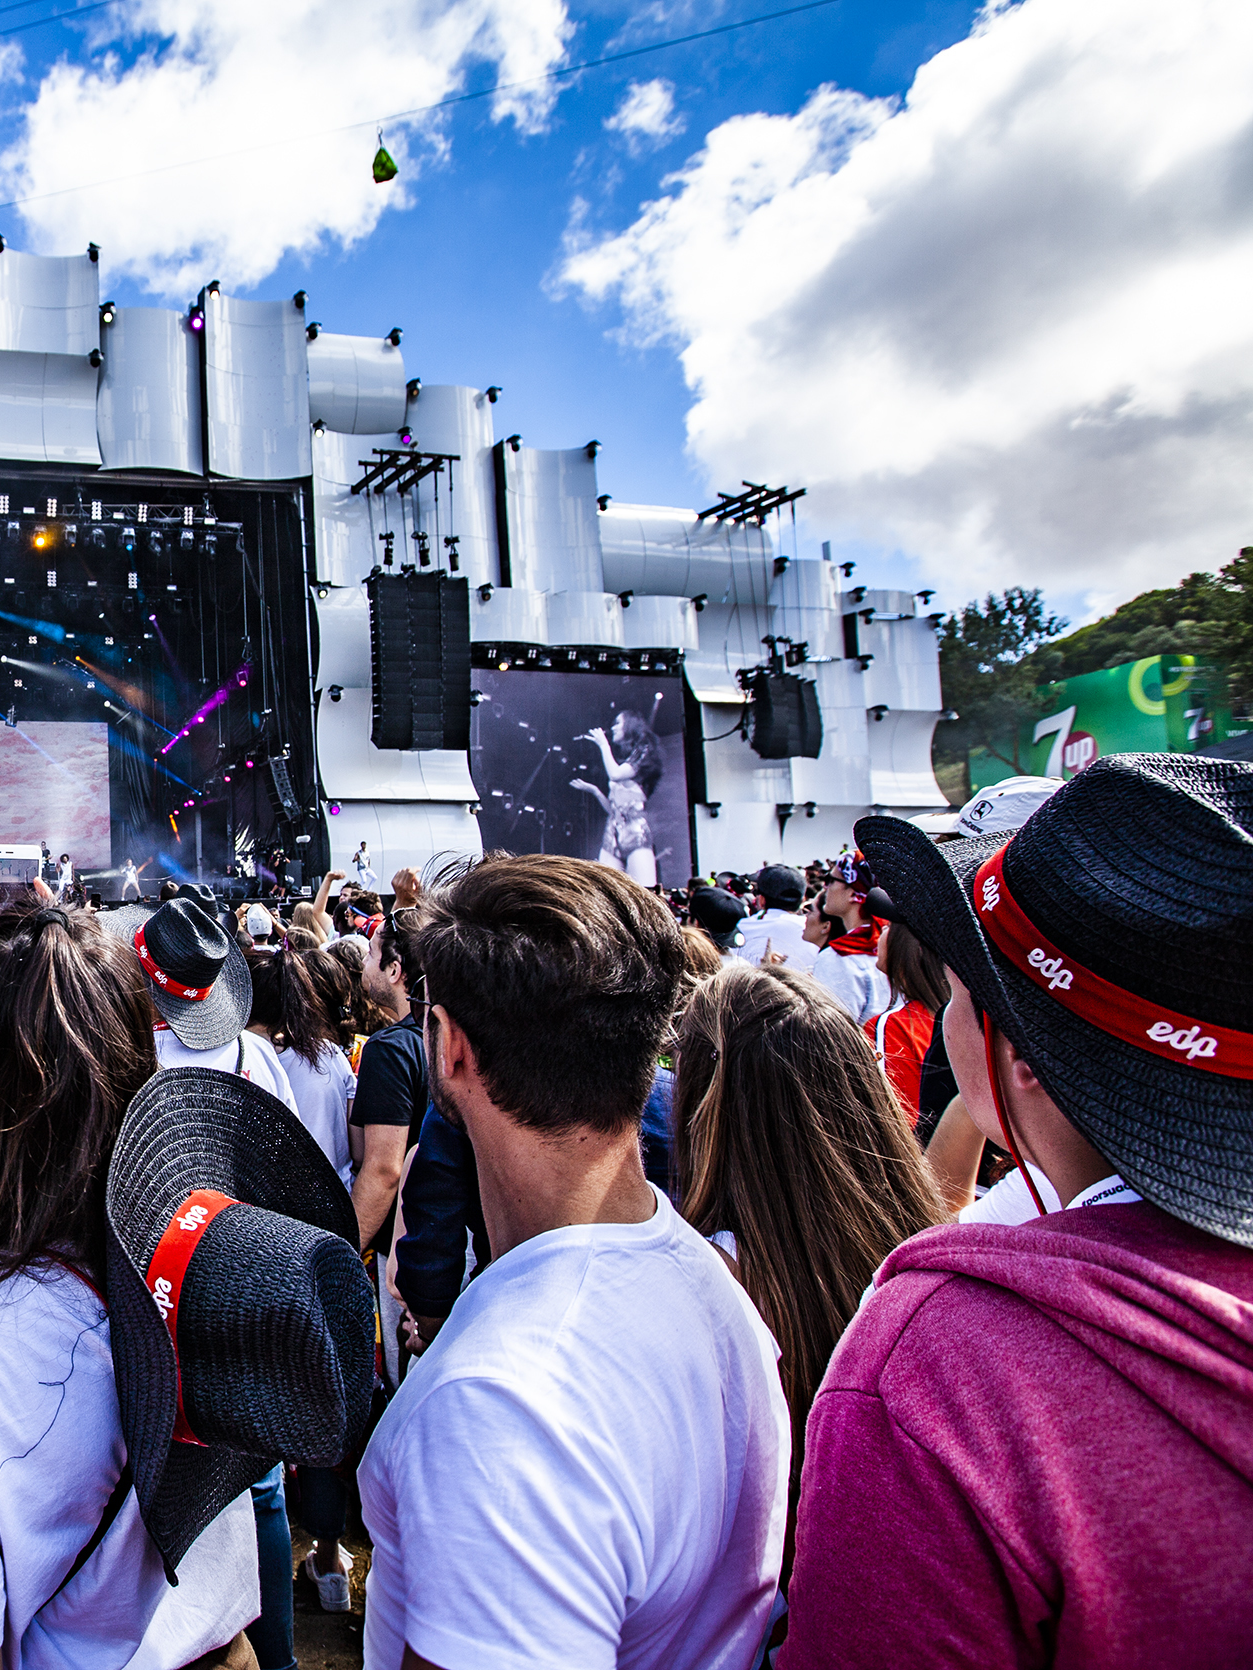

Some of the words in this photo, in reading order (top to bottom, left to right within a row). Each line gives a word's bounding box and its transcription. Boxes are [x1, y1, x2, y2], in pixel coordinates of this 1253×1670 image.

[982, 875, 1000, 911] edp
[154, 970, 168, 985] edp
[1027, 947, 1074, 990] edp
[183, 988, 198, 999] edp
[1146, 1020, 1218, 1060] edp
[176, 1204, 209, 1231] edp
